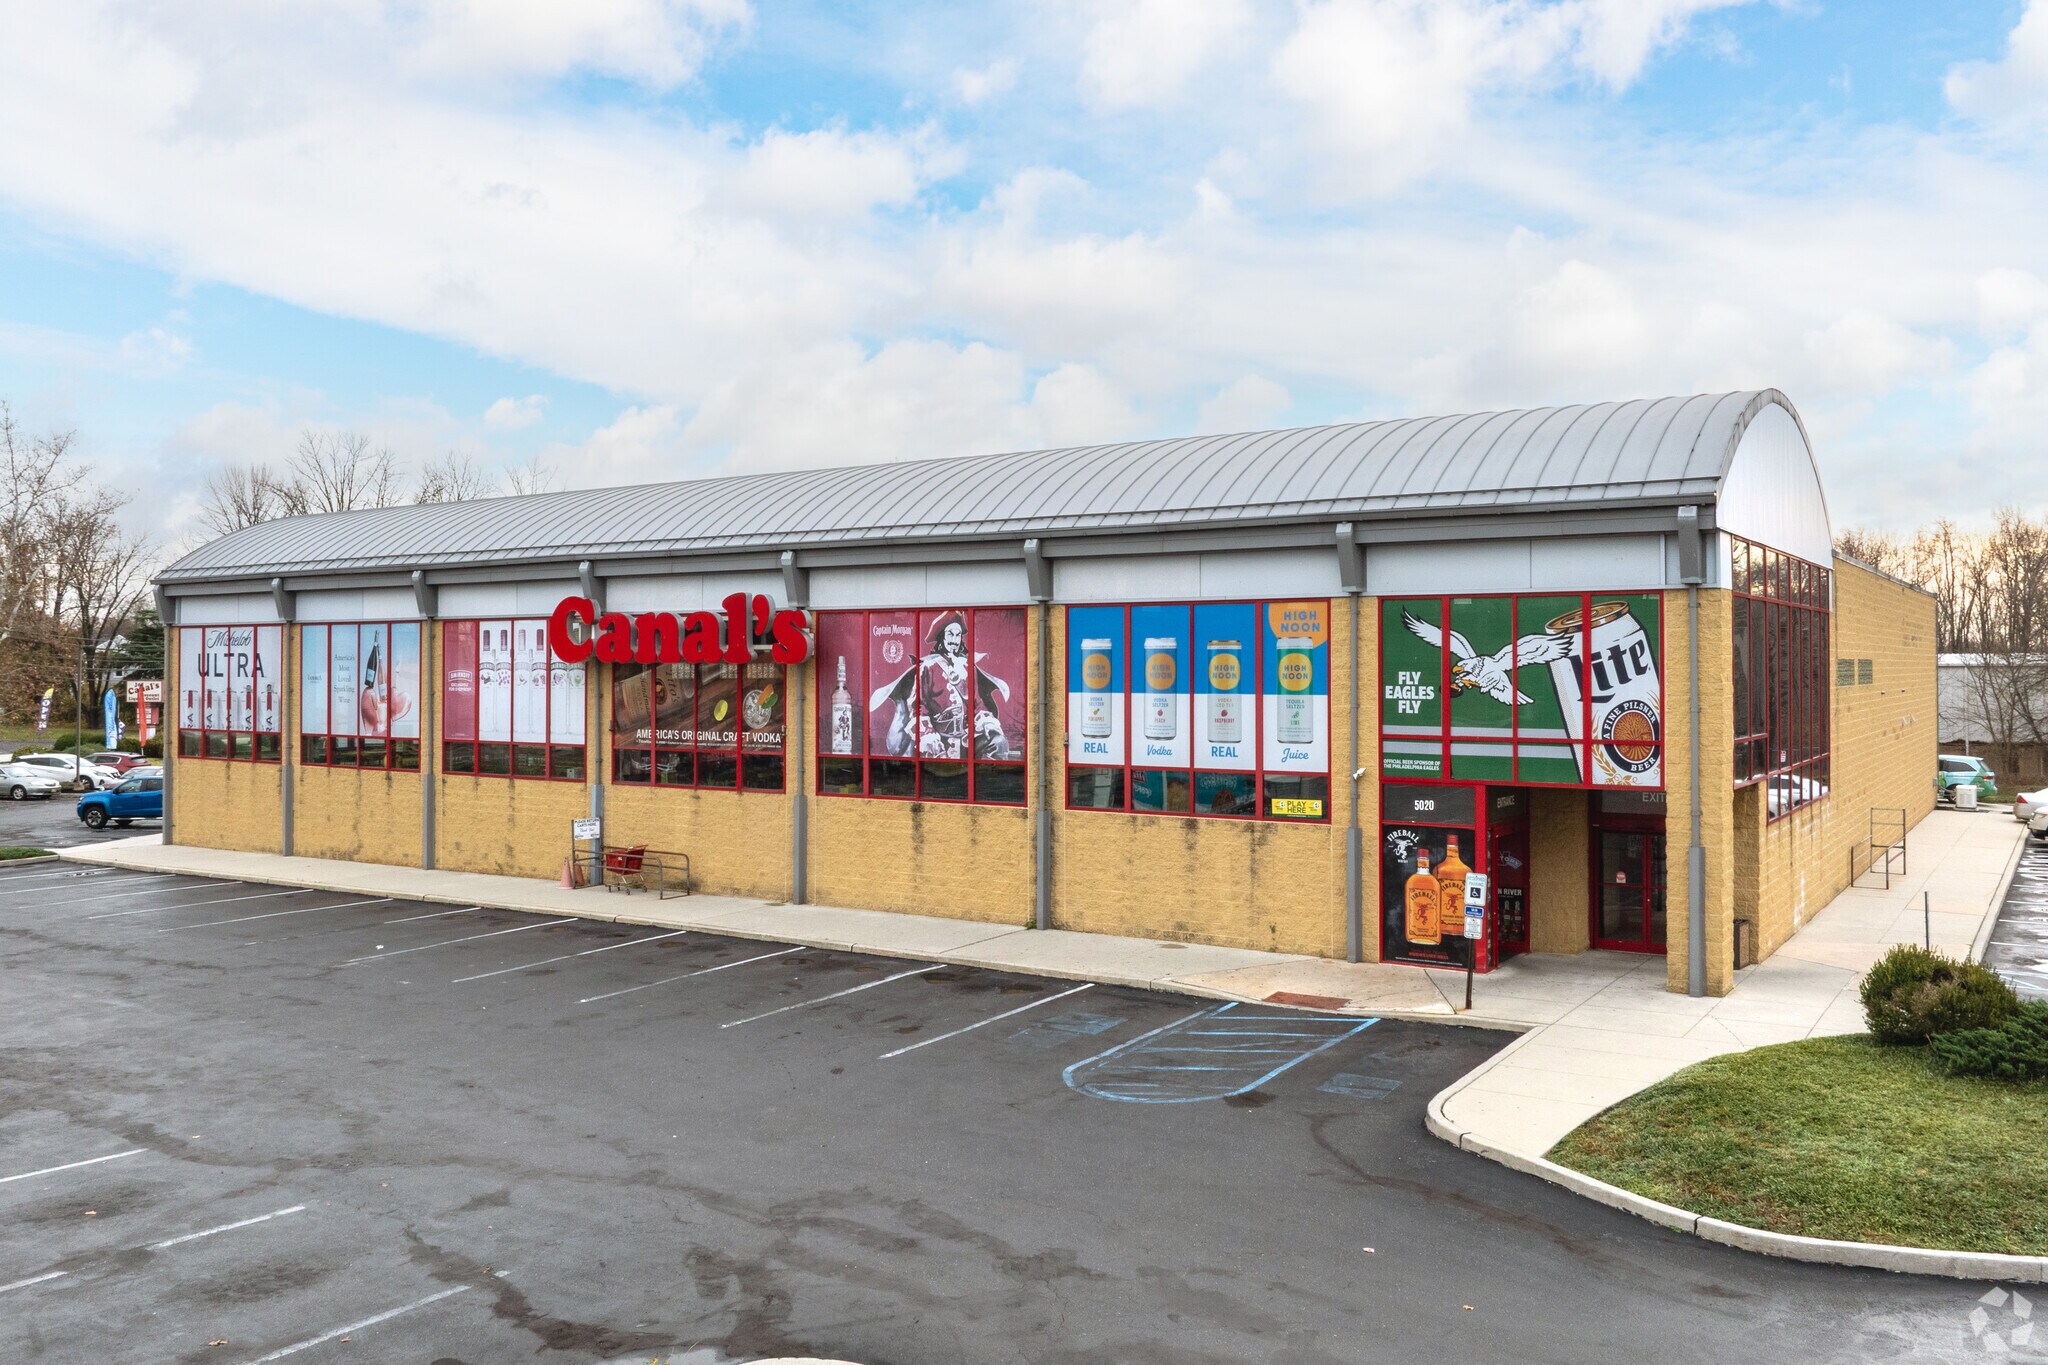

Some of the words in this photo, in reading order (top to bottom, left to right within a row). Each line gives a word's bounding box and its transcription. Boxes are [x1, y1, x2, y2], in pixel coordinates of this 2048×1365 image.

[1283, 611, 1317, 621] HIGH
[550, 592, 809, 664] Canal's
[1281, 622, 1320, 632] NOON
[207, 629, 252, 649] Michelob
[1398, 671, 1421, 685] FLY
[1385, 685, 1435, 700] EAGLES
[1398, 700, 1421, 714] FLY
[1605, 707, 1621, 731] FINE
[1623, 702, 1656, 724] PILSNER
[636, 729, 680, 741] AMERICA'S
[681, 730, 722, 742] ORIGINAL
[723, 731, 751, 743] CRAFT
[752, 732, 781, 743] VODKA
[1084, 742, 1109, 754] REAL
[1146, 744, 1173, 756] Vodka
[1211, 746, 1239, 758] REAL
[1281, 747, 1309, 763] Juice
[1631, 757, 1656, 772] BEER
[1642, 792, 1666, 803] EXIT
[1286, 806, 1307, 814] HERE
[1414, 799, 1435, 811] 5020
[1387, 829, 1420, 844] FIREBALL
[1411, 891, 1436, 902] FIREBALL
[1503, 888, 1523, 896] RIVER
